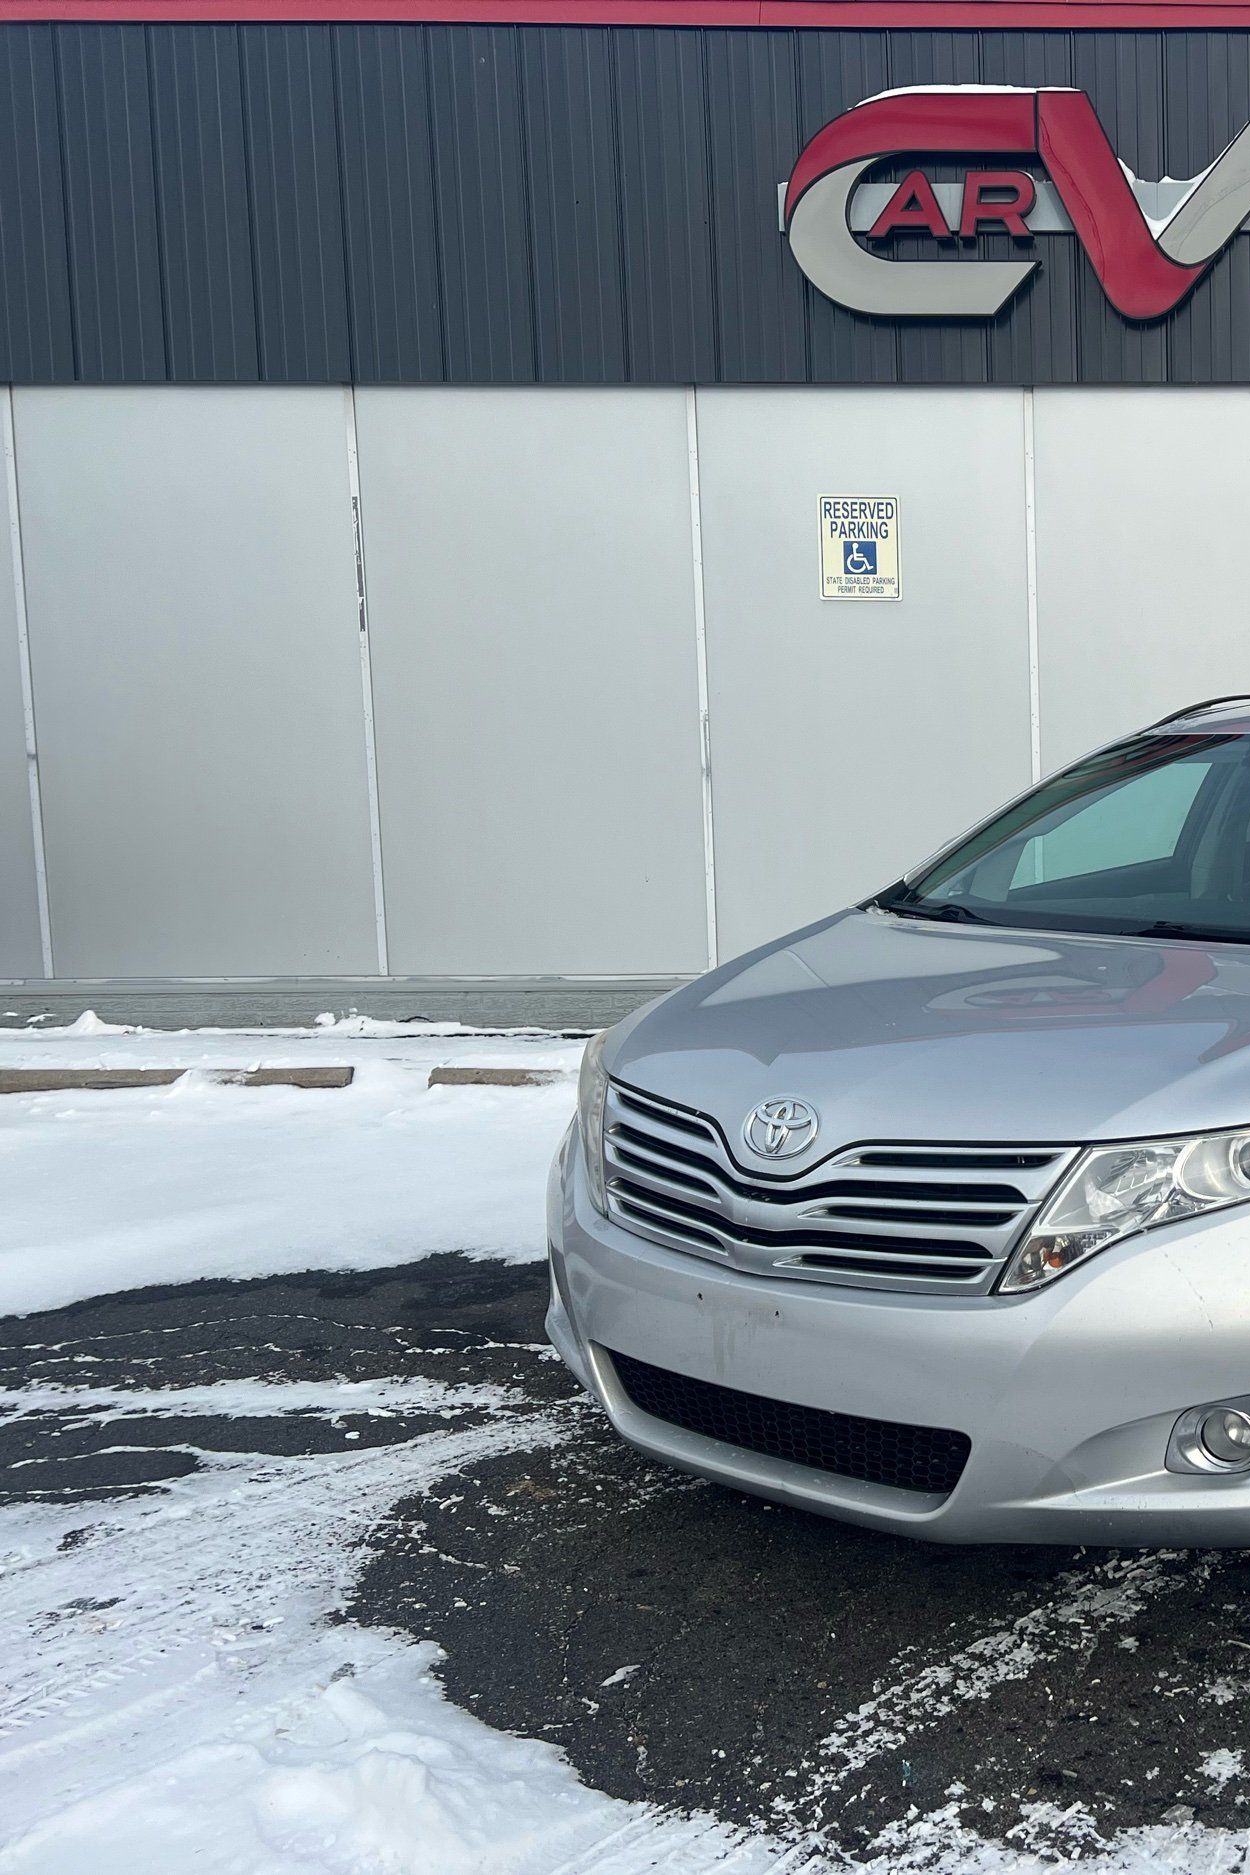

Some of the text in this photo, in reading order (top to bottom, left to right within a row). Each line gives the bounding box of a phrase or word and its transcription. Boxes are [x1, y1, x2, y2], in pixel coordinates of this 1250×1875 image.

[823, 501, 894, 519] RESERVED
[830, 521, 888, 539] PARKING
[826, 577, 896, 586] STATE DISABLED PARKING
[837, 585, 856, 594] PERMIT
[858, 586, 885, 594] REQUIRED
